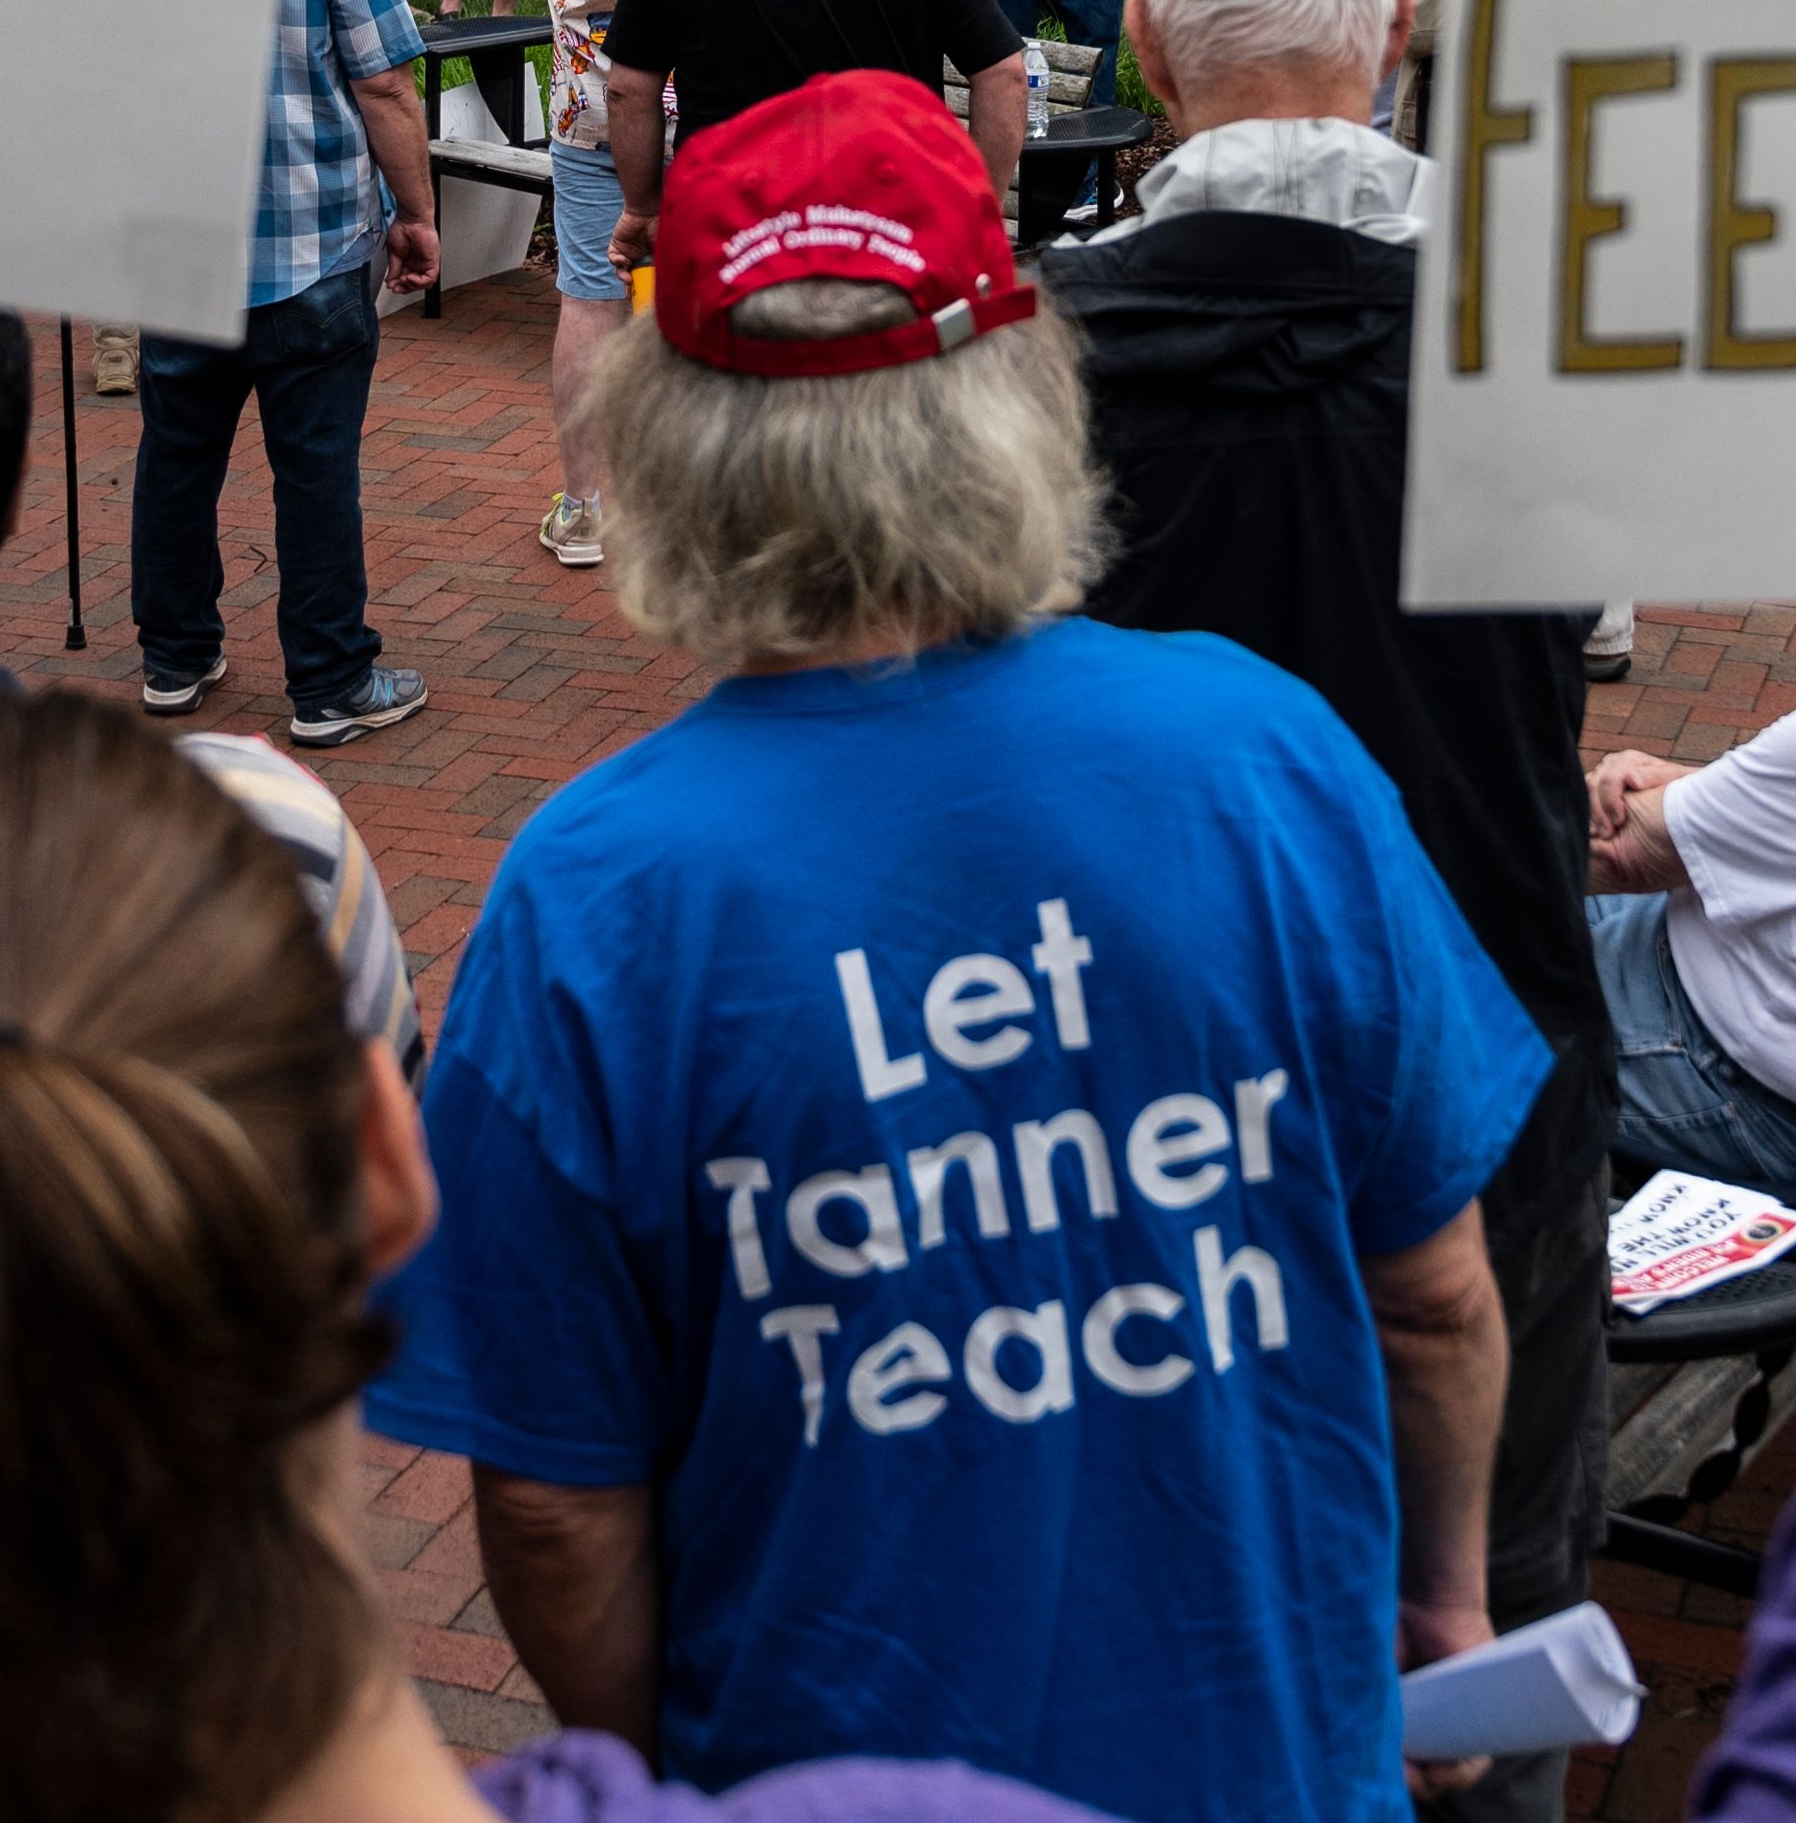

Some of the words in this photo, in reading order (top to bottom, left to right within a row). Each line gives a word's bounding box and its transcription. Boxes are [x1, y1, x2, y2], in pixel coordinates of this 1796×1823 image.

[834, 897, 1093, 1103] Let
[705, 1068, 1289, 1300] Tanner
[760, 1224, 1290, 1448] Teach
